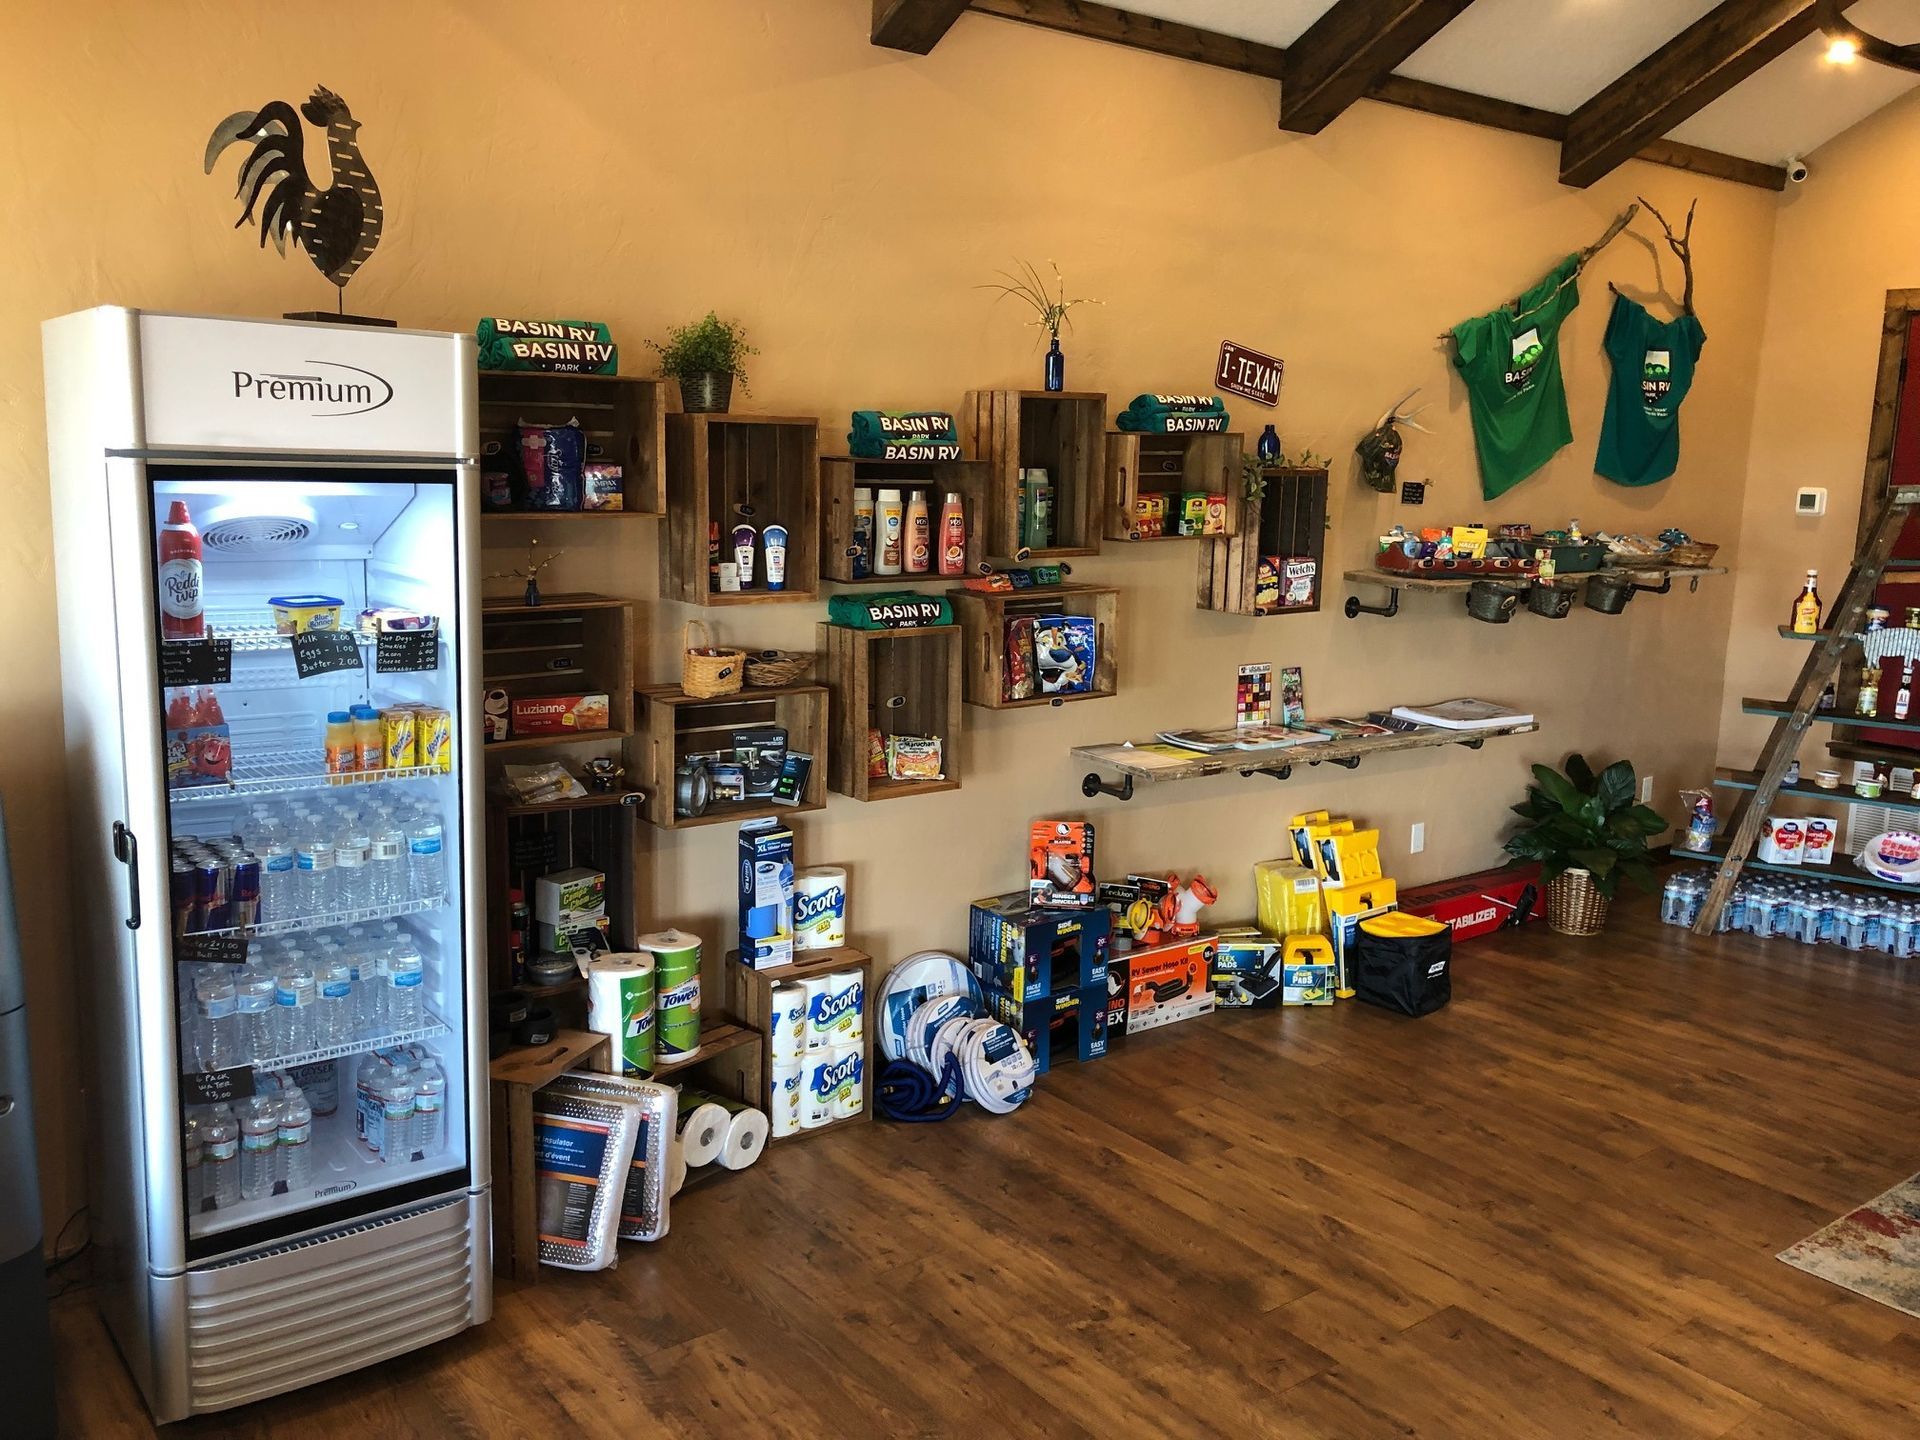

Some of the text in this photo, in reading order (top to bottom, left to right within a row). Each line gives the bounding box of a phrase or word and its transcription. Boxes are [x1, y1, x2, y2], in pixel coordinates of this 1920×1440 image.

[495, 318, 596, 341] BASIN RV
[513, 343, 613, 361] BASIN RV
[555, 363, 580, 372] PARK
[231, 371, 373, 405] Premium
[1642, 381, 1671, 392] SIN RV
[880, 416, 950, 432] BASIN RV
[1166, 418, 1223, 432] BASIN RV
[884, 446, 960, 460] BASIN RV
[1288, 563, 1315, 576] Welch's
[165, 572, 200, 597] Reddi
[313, 613, 330, 621] Blue
[869, 603, 941, 621] BASIN RV
[899, 620, 918, 628] PARK
[297, 633, 350, 646] Milk 2.00
[299, 645, 354, 660] Eggs 1.00
[338, 657, 359, 666] 2.00
[516, 703, 566, 715] Luzianne
[757, 844, 768, 853] XL
[795, 886, 840, 921] Scott
[1217, 955, 1236, 963] FLEX
[1217, 961, 1238, 969] PADS
[1091, 965, 1106, 975] EASY
[1131, 968, 1141, 977] RV
[1141, 964, 1162, 975] Sewer
[1162, 960, 1180, 970] Hose
[1292, 975, 1314, 985] PADS
[662, 985, 699, 1009] Towels
[817, 981, 860, 1022] Scott
[1107, 998, 1126, 1010] INO
[635, 1013, 655, 1034] Tow
[1107, 1010, 1125, 1026] EX
[1090, 1040, 1105, 1050] EASY
[303, 1063, 335, 1077] GEYSER
[820, 1051, 858, 1093] Scott
[205, 1073, 230, 1082] PACK
[198, 1081, 233, 1091] WATER
[542, 1135, 574, 1147] insulator
[544, 1151, 571, 1162] d'évent
[314, 1184, 351, 1199] Premium
